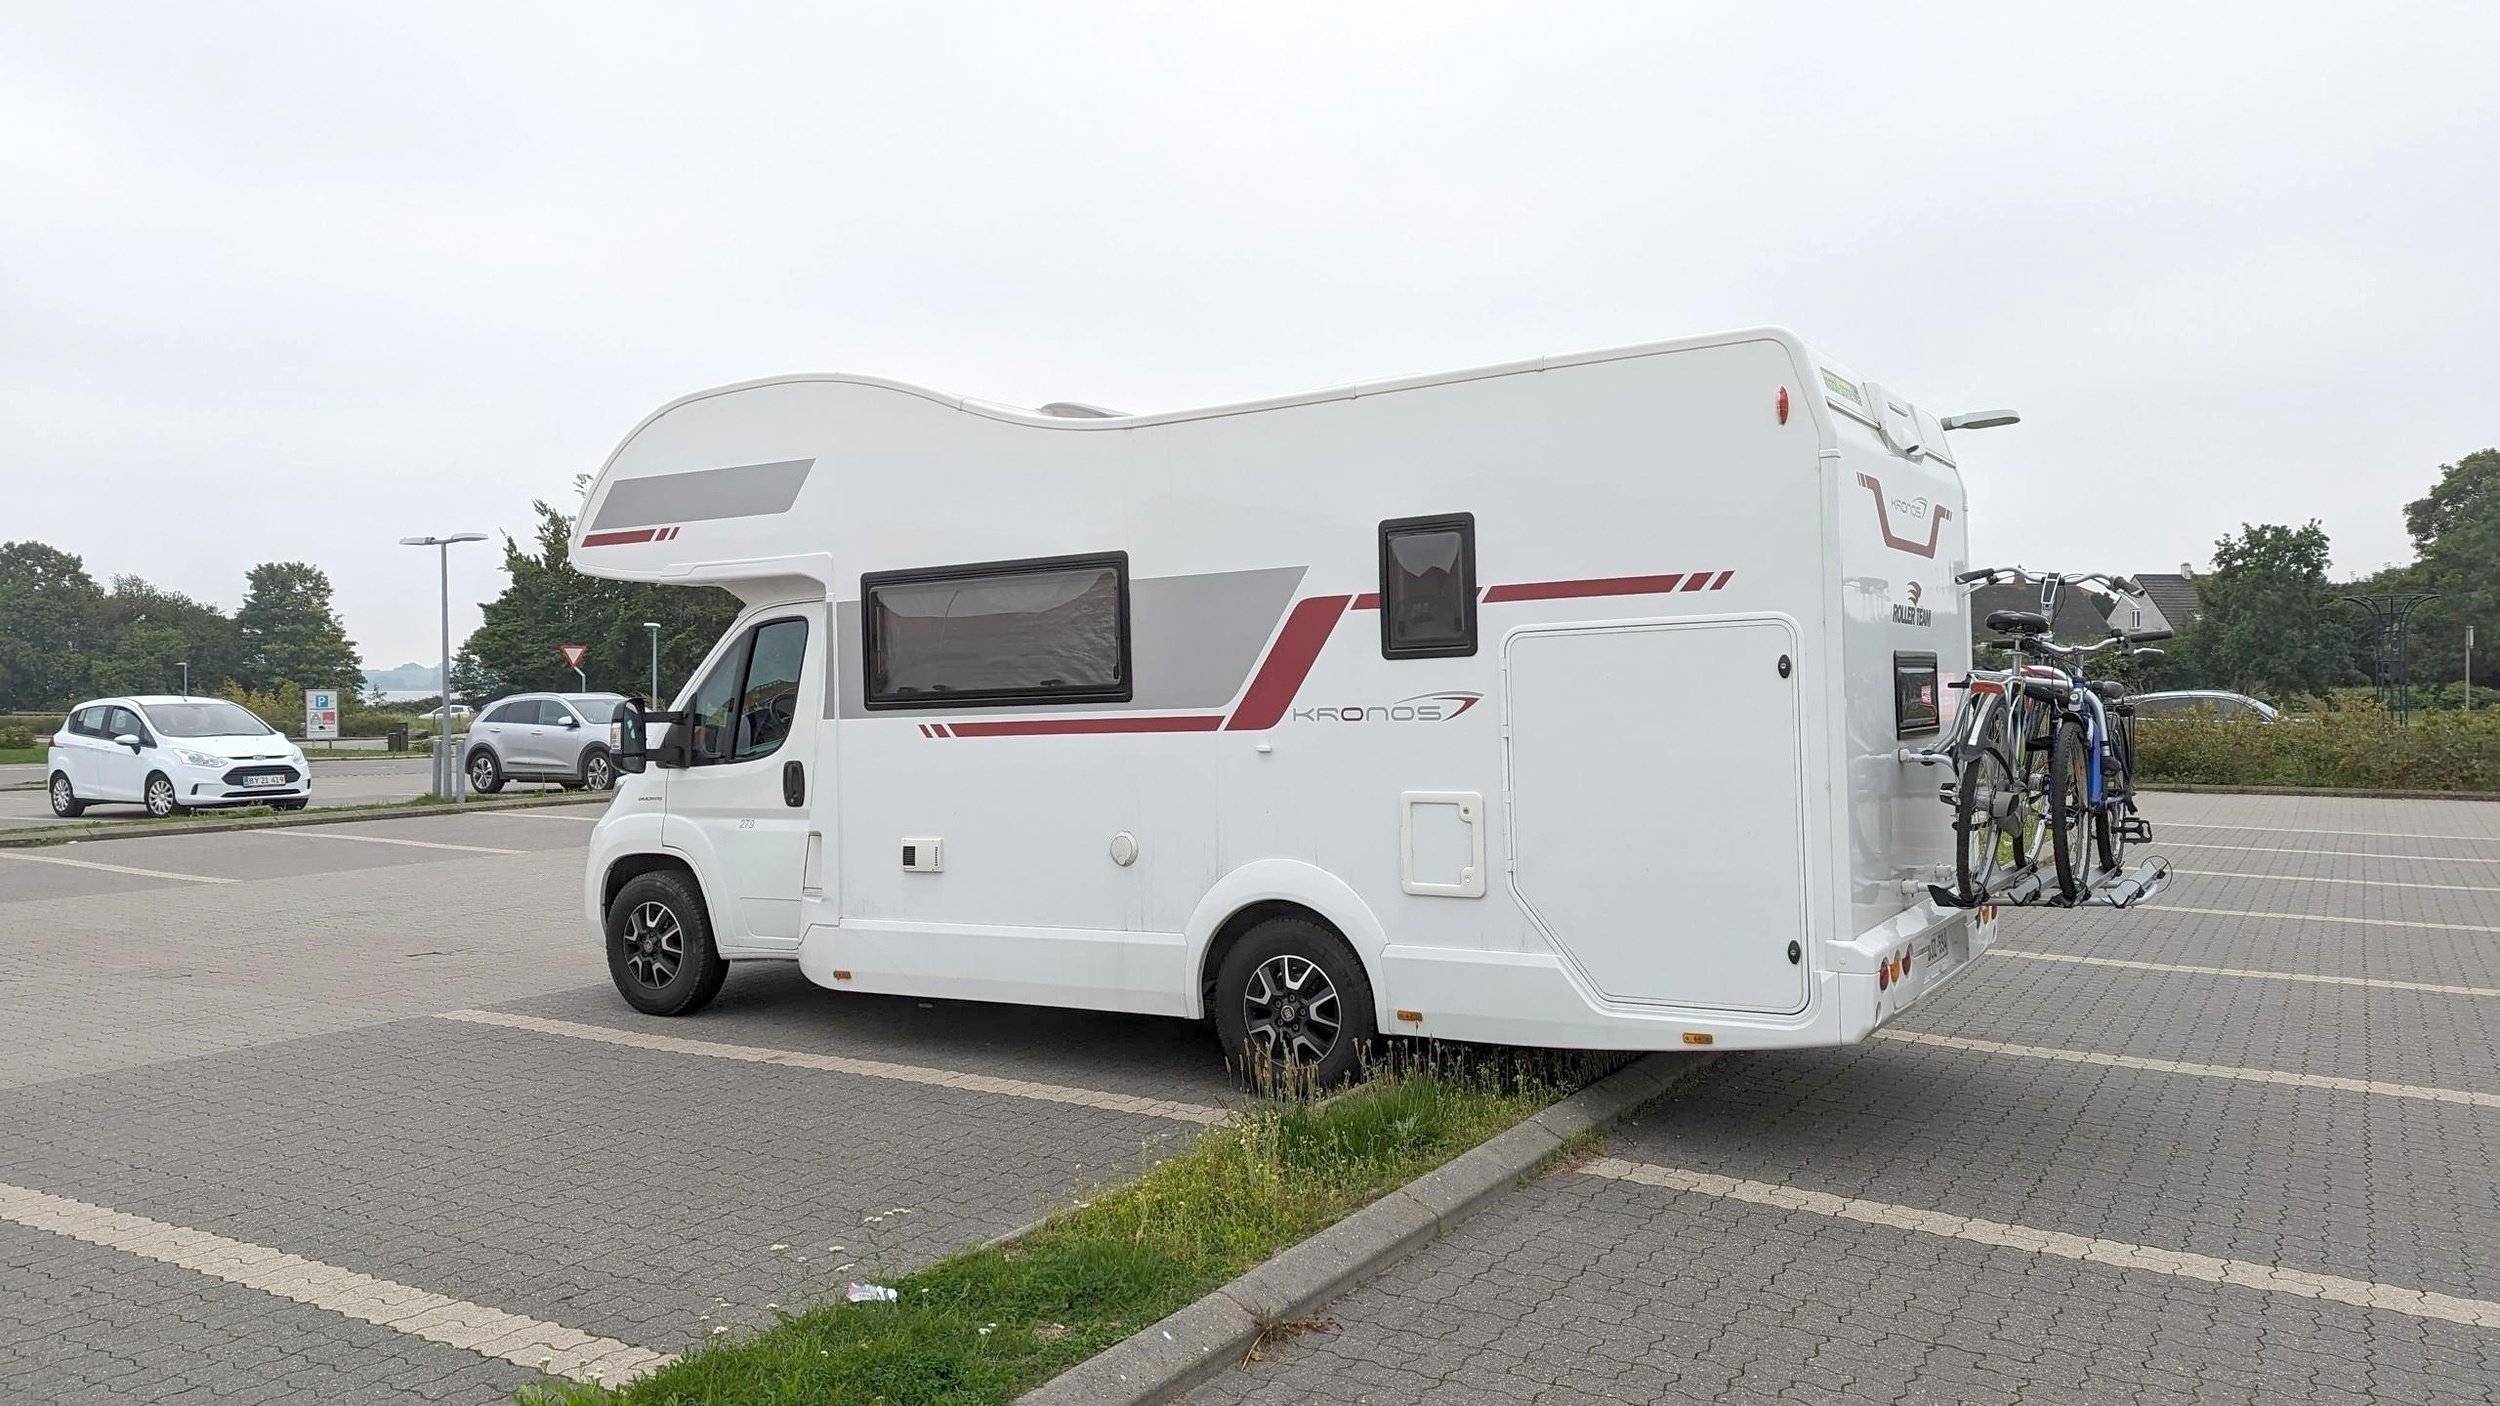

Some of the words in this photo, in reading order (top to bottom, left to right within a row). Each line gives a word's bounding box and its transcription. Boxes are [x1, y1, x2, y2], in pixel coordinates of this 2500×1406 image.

[1892, 603, 1915, 625] ROLLER
[1916, 607, 1932, 628] TEAM
[318, 696, 326, 707] P
[1292, 705, 1442, 722] KRONOS
